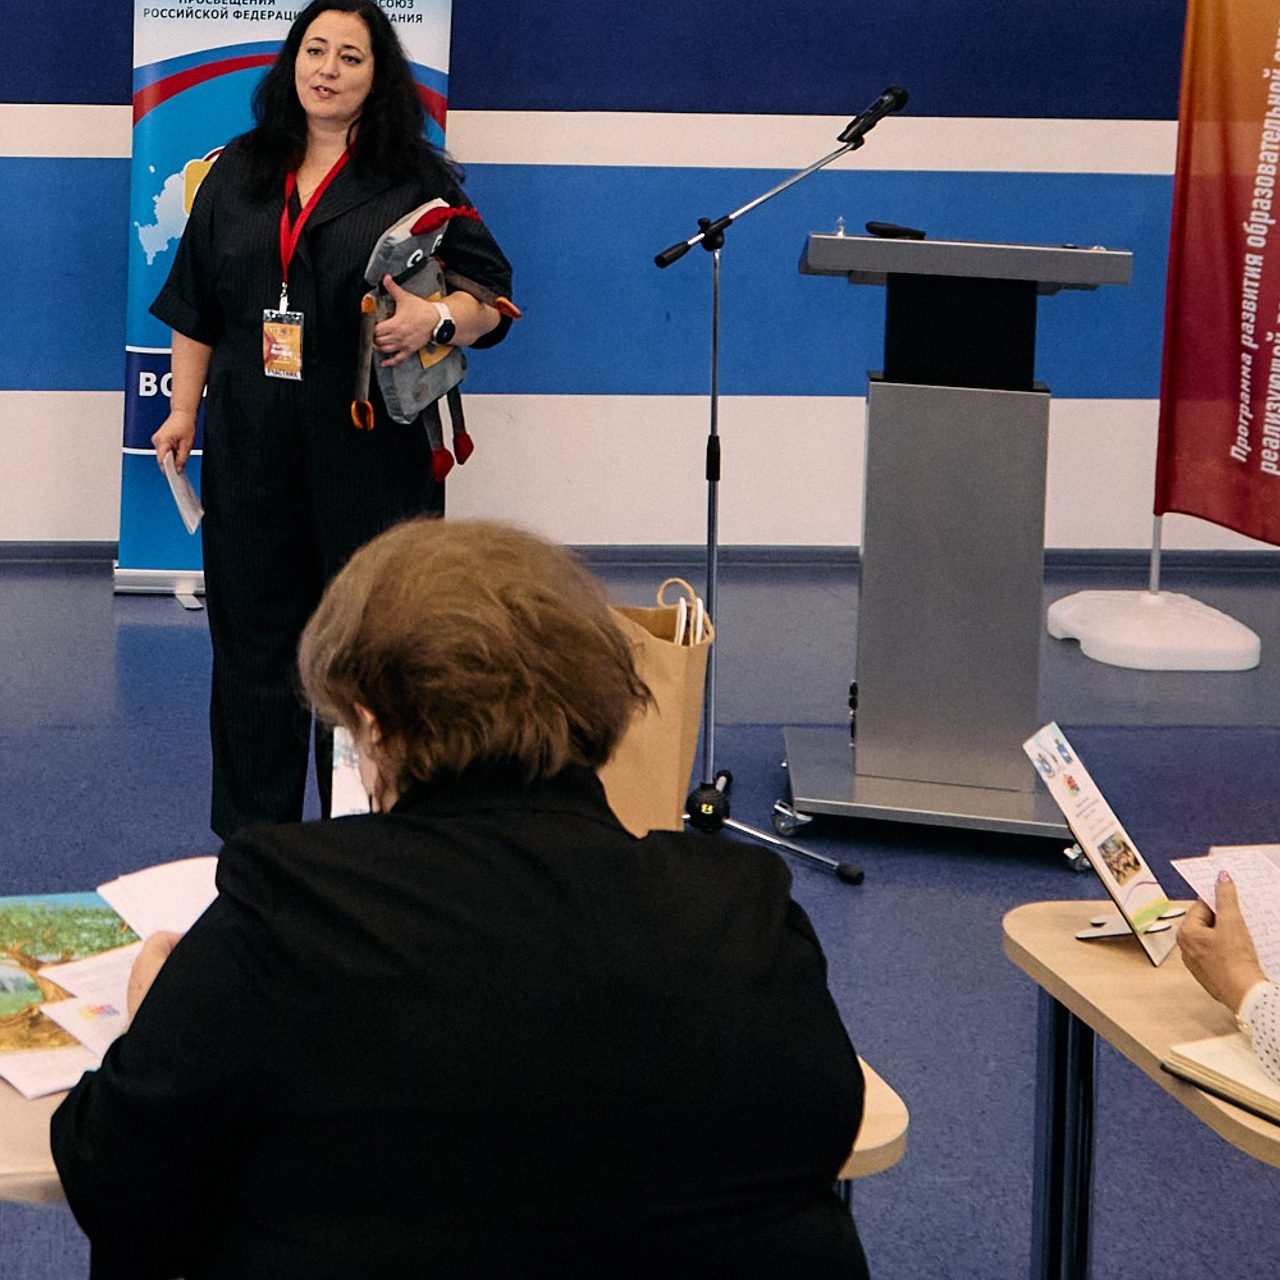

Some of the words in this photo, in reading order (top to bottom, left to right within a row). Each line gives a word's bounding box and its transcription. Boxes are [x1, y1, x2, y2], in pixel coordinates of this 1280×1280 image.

[143, 7, 229, 20] РОССИЙСКОЙ
[1241, 253, 1264, 350] развития
[1230, 352, 1253, 462] Программа
